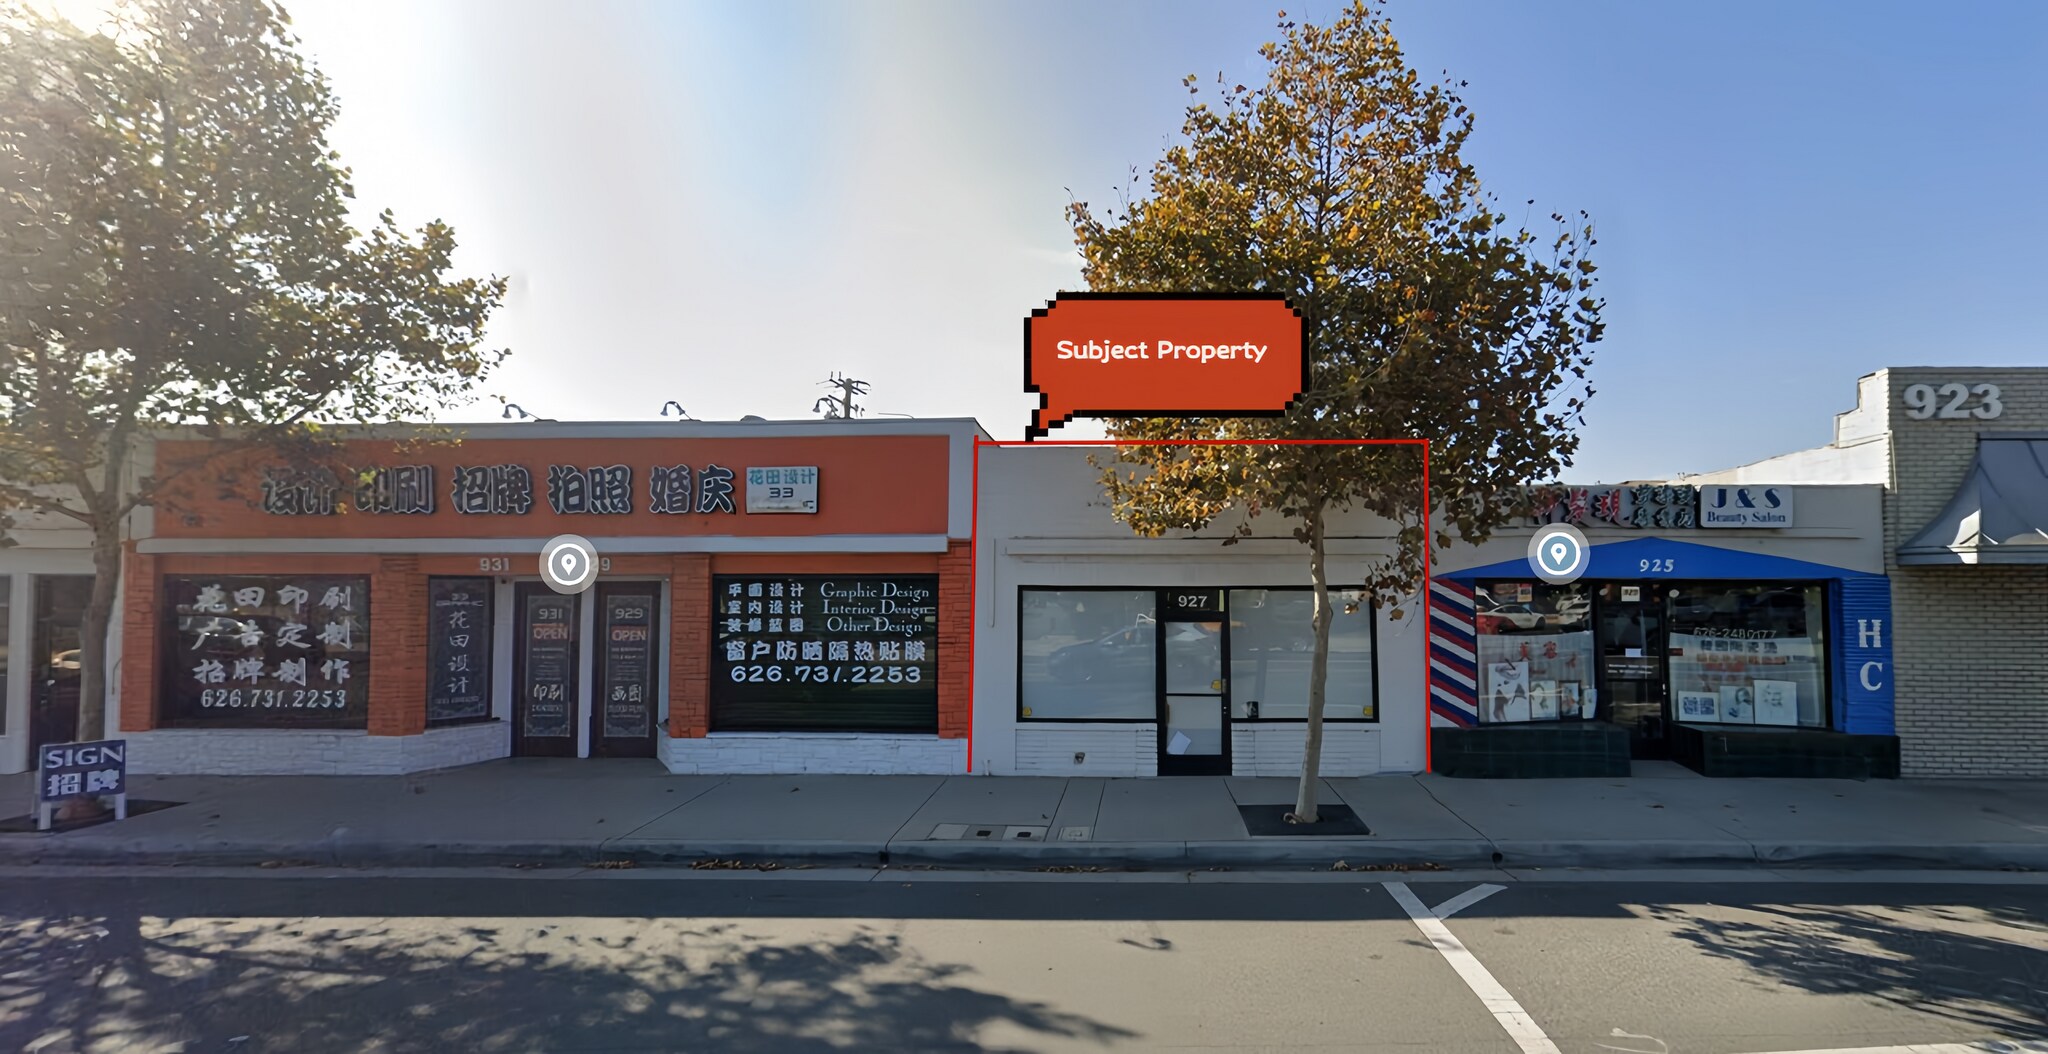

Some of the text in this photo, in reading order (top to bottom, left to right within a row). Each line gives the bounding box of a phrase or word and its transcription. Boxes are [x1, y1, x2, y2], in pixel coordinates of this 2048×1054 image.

[1903, 383, 2003, 420] 923
[748, 469, 816, 485] 花田设计
[354, 465, 434, 514] 印刷
[450, 464, 531, 514] 招牌
[547, 464, 632, 514] 拍照
[650, 464, 737, 514] 婚庆
[1711, 488, 1727, 508] J
[1735, 488, 1756, 508] &
[1764, 488, 1781, 508] S
[1707, 511, 1786, 525] Beauty Salon
[479, 557, 510, 571] 931
[1639, 559, 1675, 573] 925
[193, 584, 351, 614] 花田印刷
[728, 583, 804, 597] 平面设计
[820, 582, 929, 602] Graphic Design
[728, 600, 804, 614] 室内设计
[822, 600, 926, 619] Interior Design
[1178, 595, 1208, 607] 927
[538, 608, 563, 619] 931
[615, 608, 643, 619] 929
[191, 619, 352, 650] 广告定制
[533, 626, 568, 640] OPEN
[611, 629, 647, 641] OPEN
[826, 616, 922, 637] Other Design
[726, 640, 926, 661] 窗户防晒隔热贴膜
[192, 657, 350, 686] 招牌制作
[731, 665, 921, 683] 626.731.2253
[201, 689, 346, 708] 626.731.2253
[533, 684, 563, 701] 印刷
[45, 745, 124, 769] SIGN
